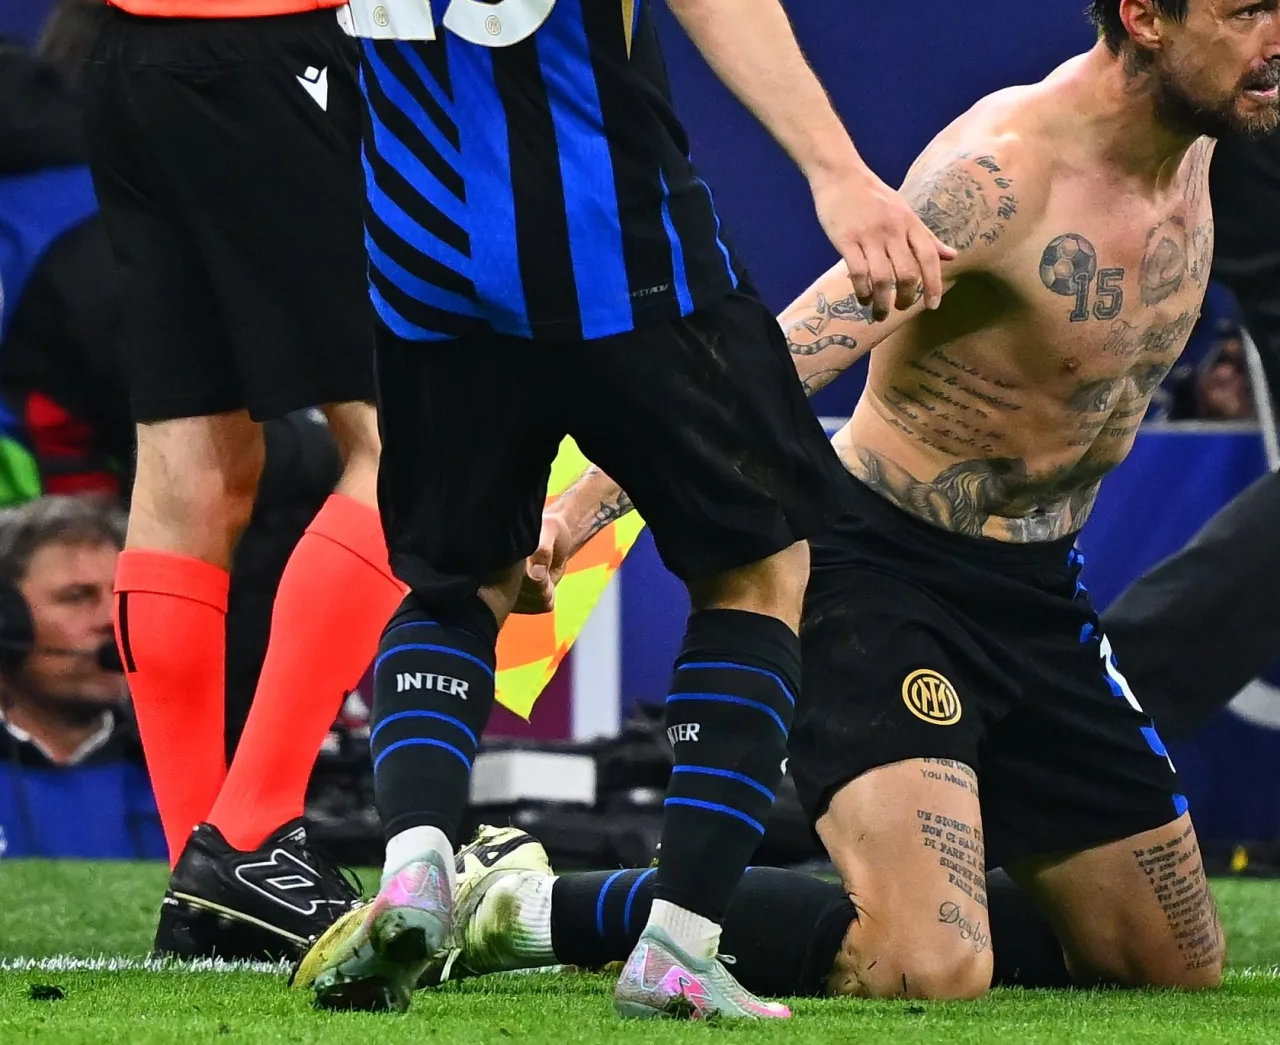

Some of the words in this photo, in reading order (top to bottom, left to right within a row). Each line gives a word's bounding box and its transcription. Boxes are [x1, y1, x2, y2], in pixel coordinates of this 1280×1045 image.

[1069, 267, 1125, 323] 15
[396, 672, 469, 700] INTER
[667, 722, 701, 747] NTER
[920, 768, 942, 780] You
[921, 823, 943, 839] NON
